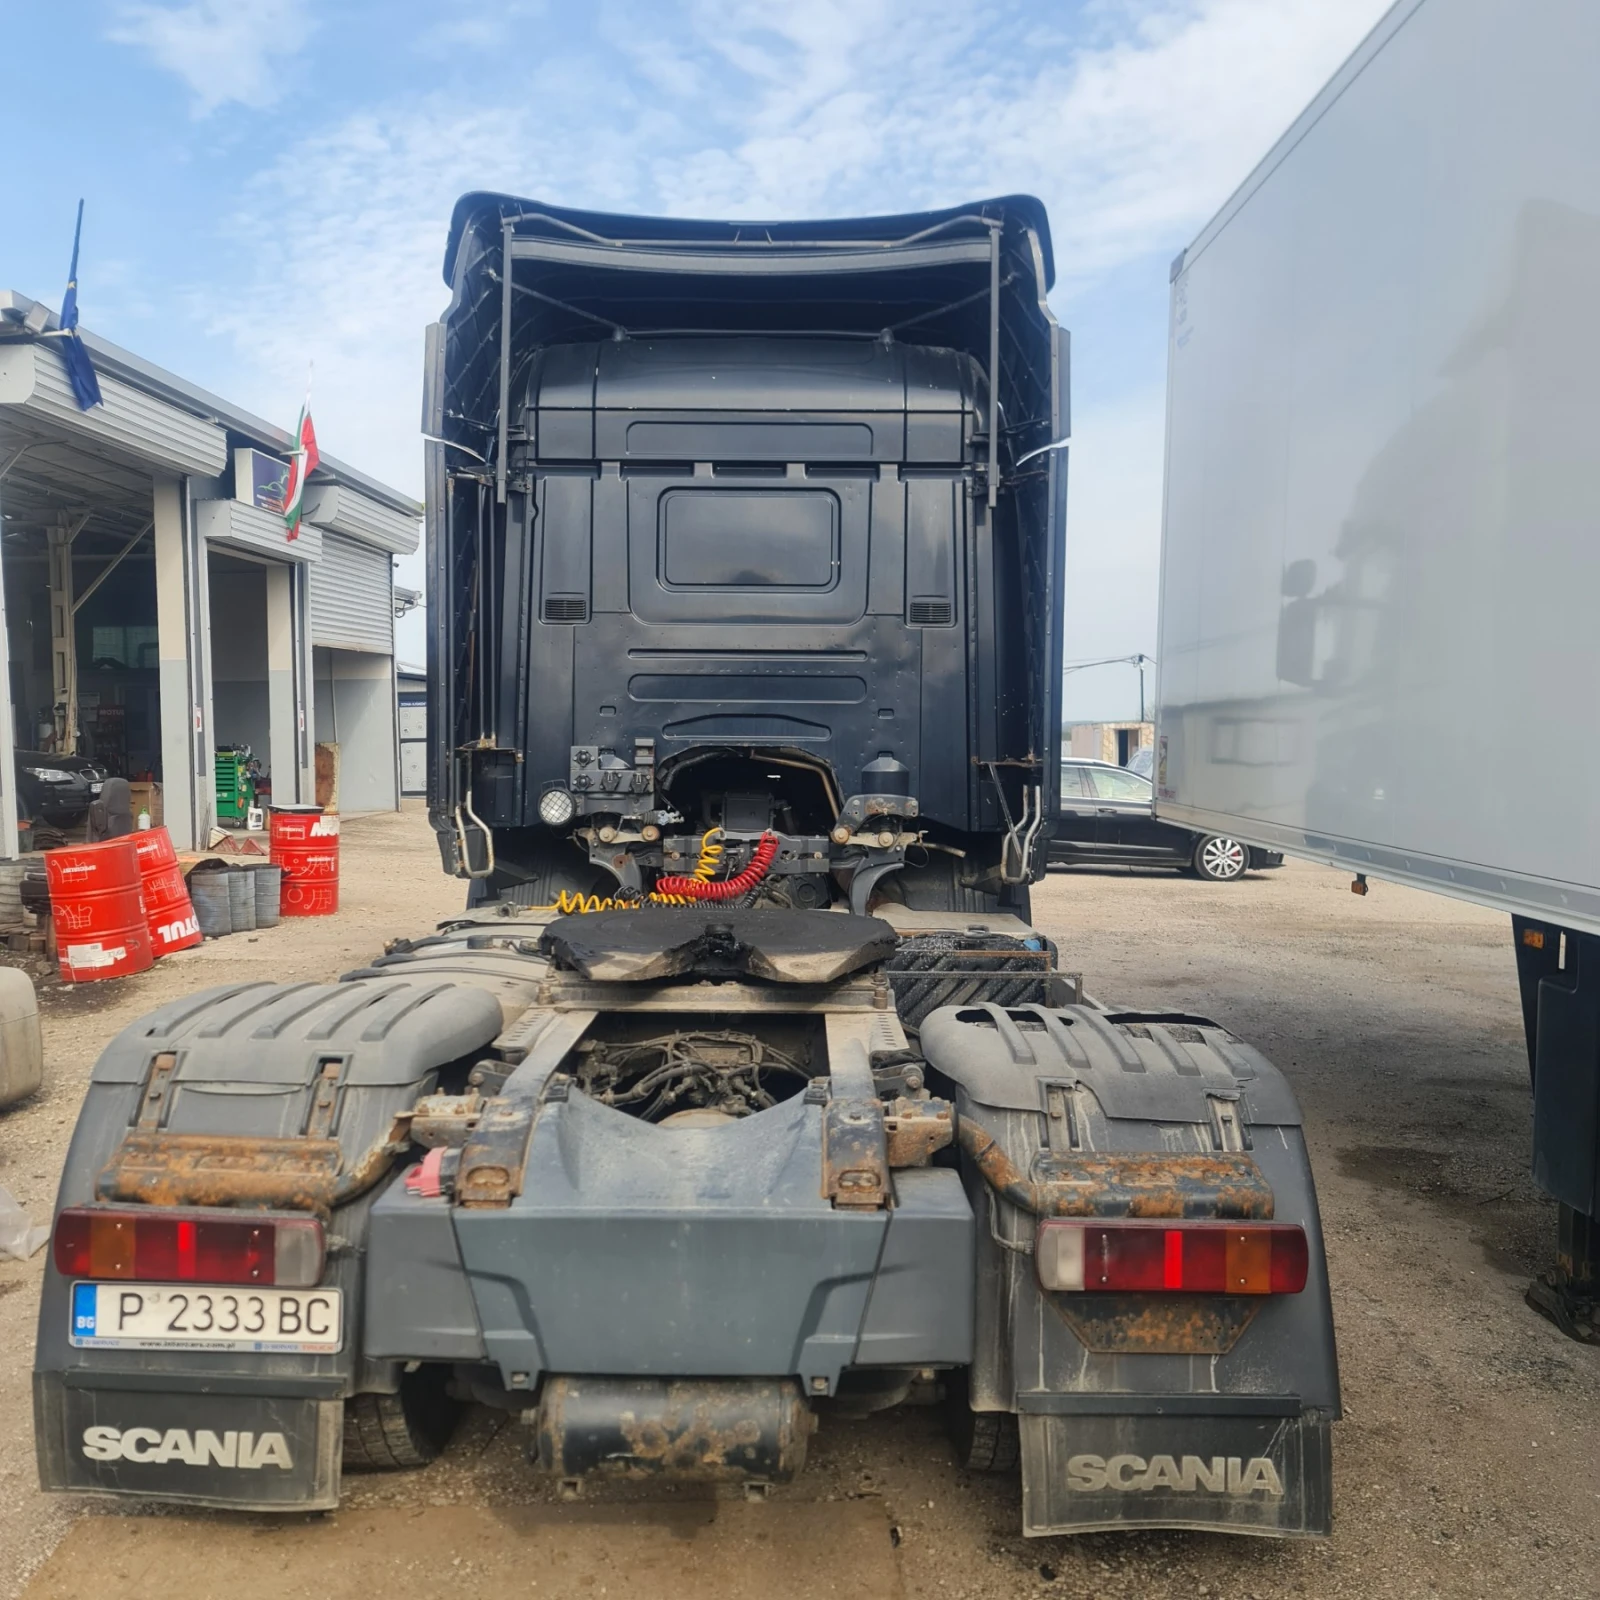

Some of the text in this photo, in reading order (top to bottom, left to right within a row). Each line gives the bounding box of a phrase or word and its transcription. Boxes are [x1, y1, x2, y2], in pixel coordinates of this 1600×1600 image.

[76, 1315, 95, 1328] BG
[118, 1292, 331, 1335] P 2333 BC
[83, 1425, 294, 1470] SCANIA
[1067, 1454, 1284, 1495] SCANIA
